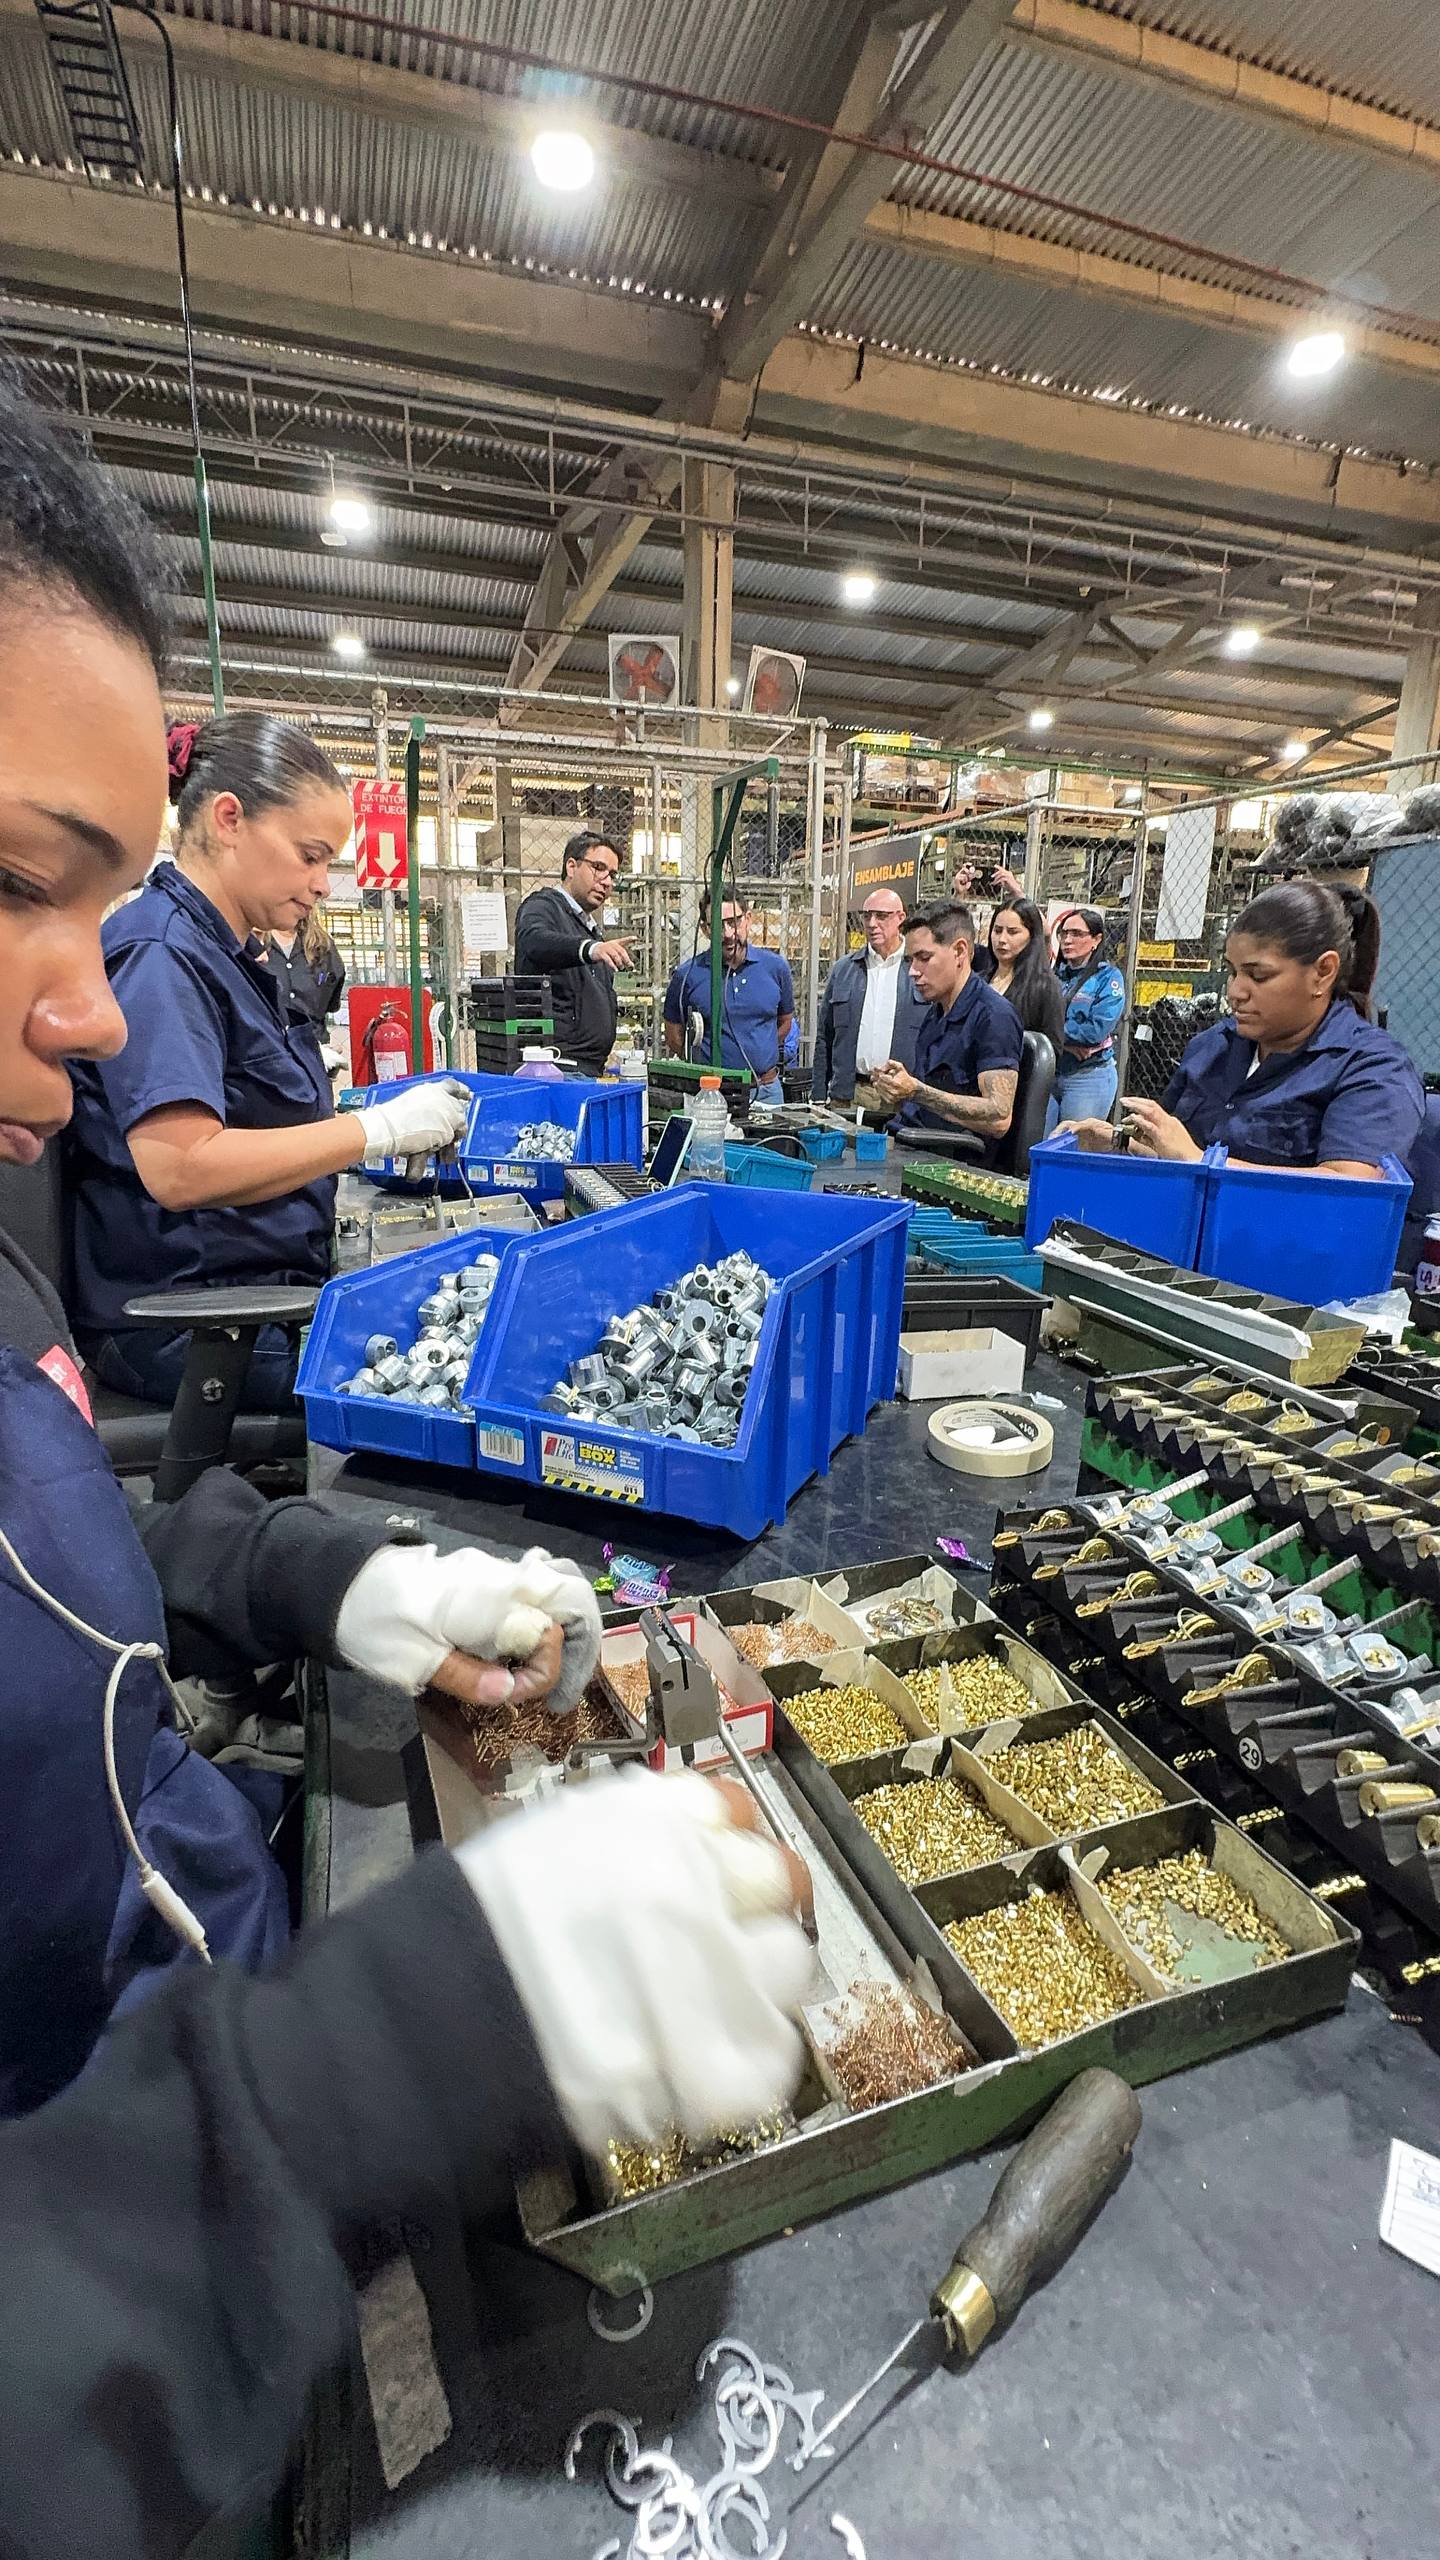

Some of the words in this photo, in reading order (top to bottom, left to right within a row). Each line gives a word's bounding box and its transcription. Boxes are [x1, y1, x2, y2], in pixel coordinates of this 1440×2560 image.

[360, 804, 373, 813] DE
[855, 860, 915, 887] ENSAMBLAJE
[580, 1441, 616, 1455] PRACTI
[580, 1447, 616, 1465] BOX
[1241, 1742, 1260, 1766] 29
